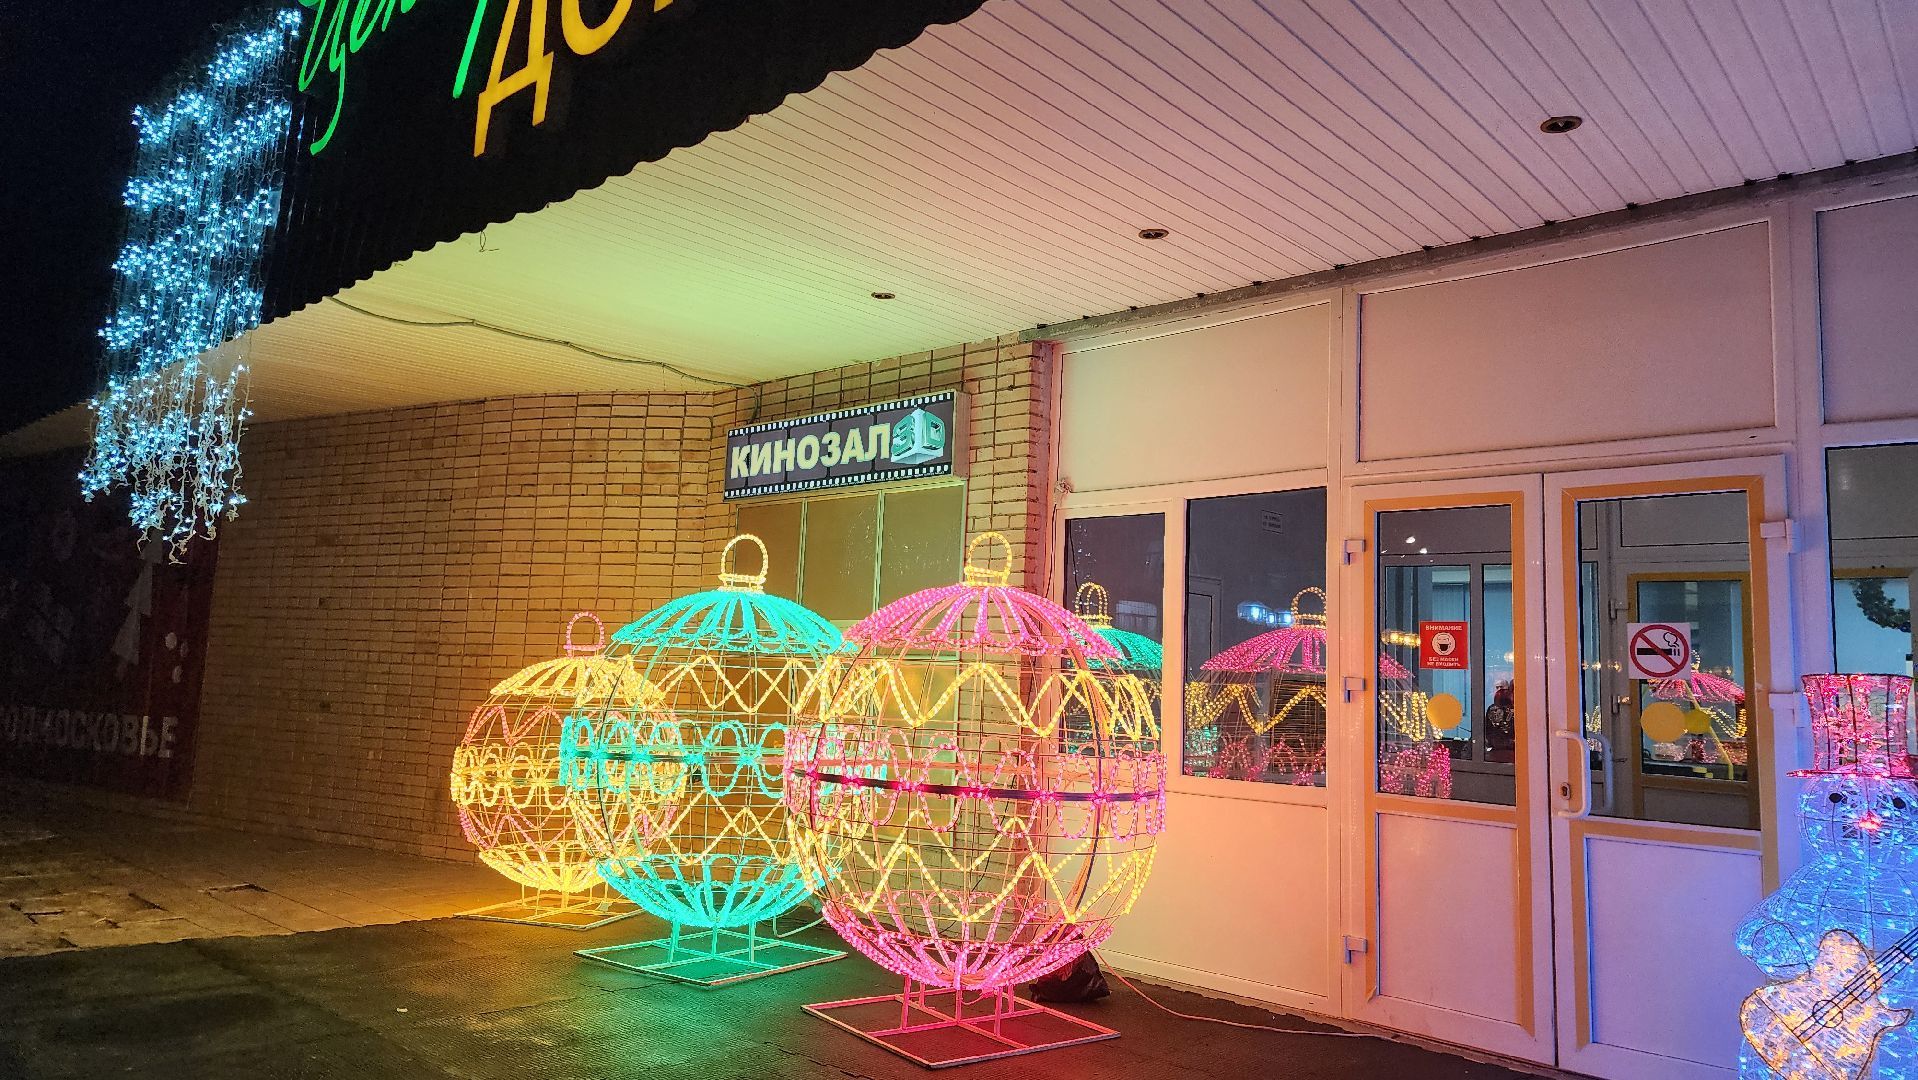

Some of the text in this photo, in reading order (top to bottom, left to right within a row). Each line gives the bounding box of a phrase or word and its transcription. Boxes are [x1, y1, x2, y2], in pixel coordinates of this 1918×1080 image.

[730, 407, 946, 479] КИНОЗАЛ 3D
[0, 703, 179, 759] ОДМОСКОВЬЕ
